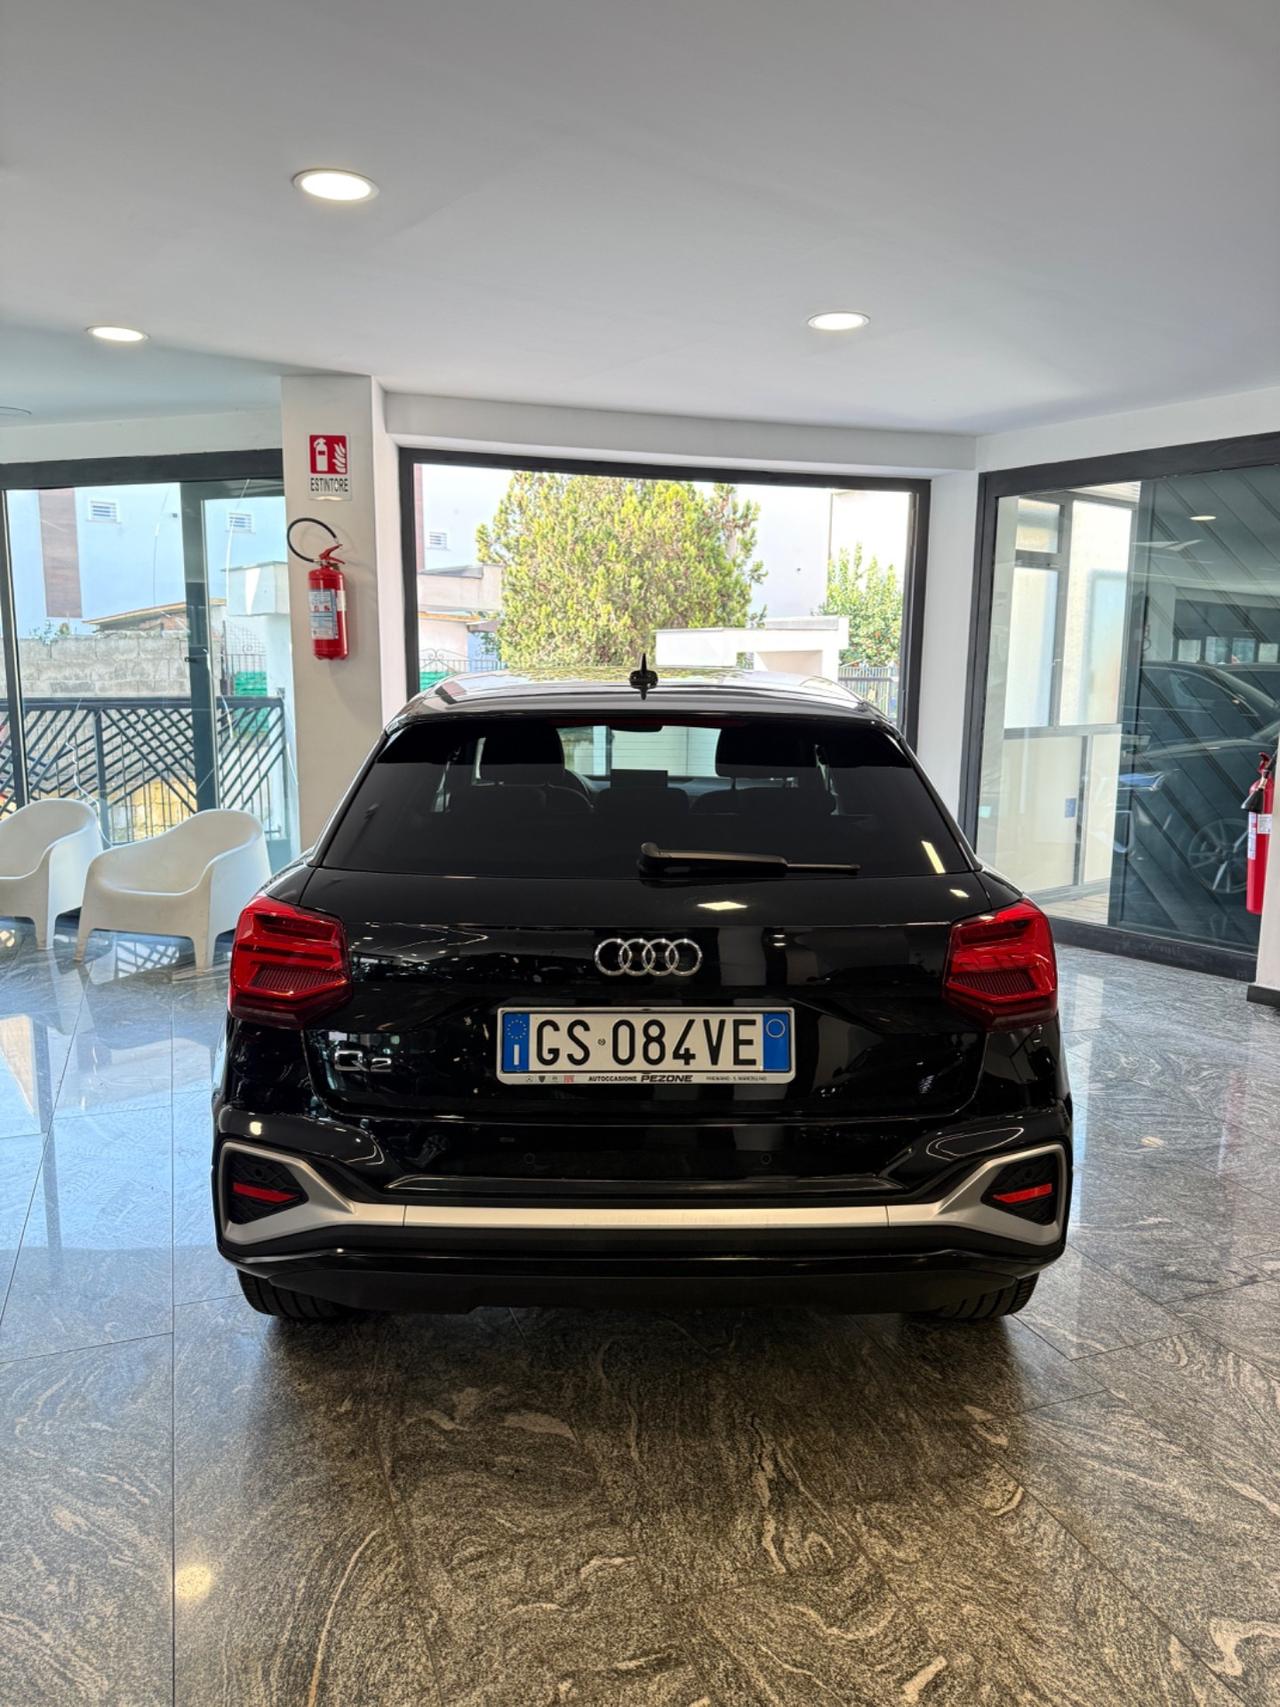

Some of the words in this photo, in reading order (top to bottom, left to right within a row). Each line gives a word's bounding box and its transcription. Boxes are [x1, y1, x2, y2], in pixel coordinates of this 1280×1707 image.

[310, 477, 349, 492] ESTINTORE
[536, 1019, 591, 1066] GS
[612, 1019, 757, 1066] 084VE
[334, 1050, 392, 1072] Q2
[640, 1074, 694, 1083] PEZONE
